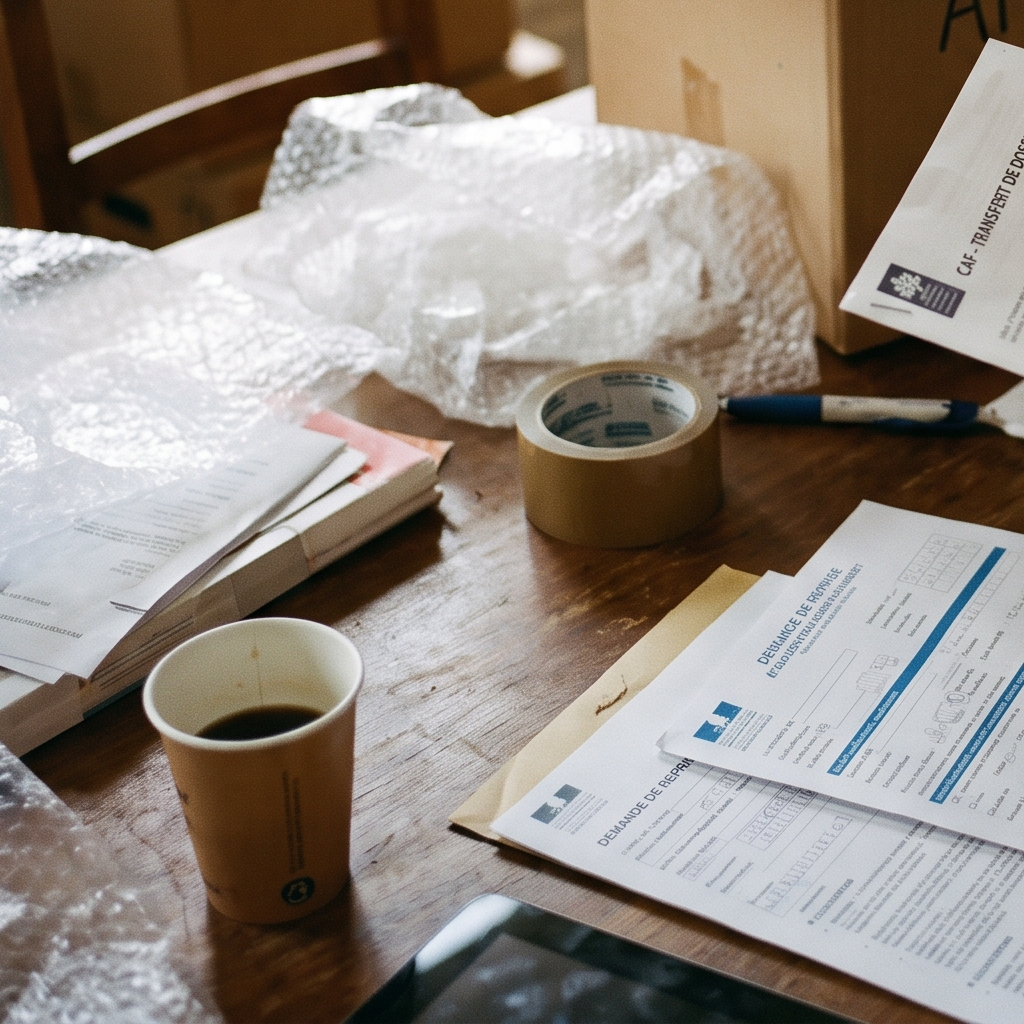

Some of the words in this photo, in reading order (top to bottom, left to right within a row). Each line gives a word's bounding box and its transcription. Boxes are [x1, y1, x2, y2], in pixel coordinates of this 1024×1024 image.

[956, 252, 978, 277] CAF
[1002, 167, 1021, 186] DE
[795, 602, 813, 618] DE
[596, 801, 650, 847] DEMANDE
[643, 787, 664, 802] DE
